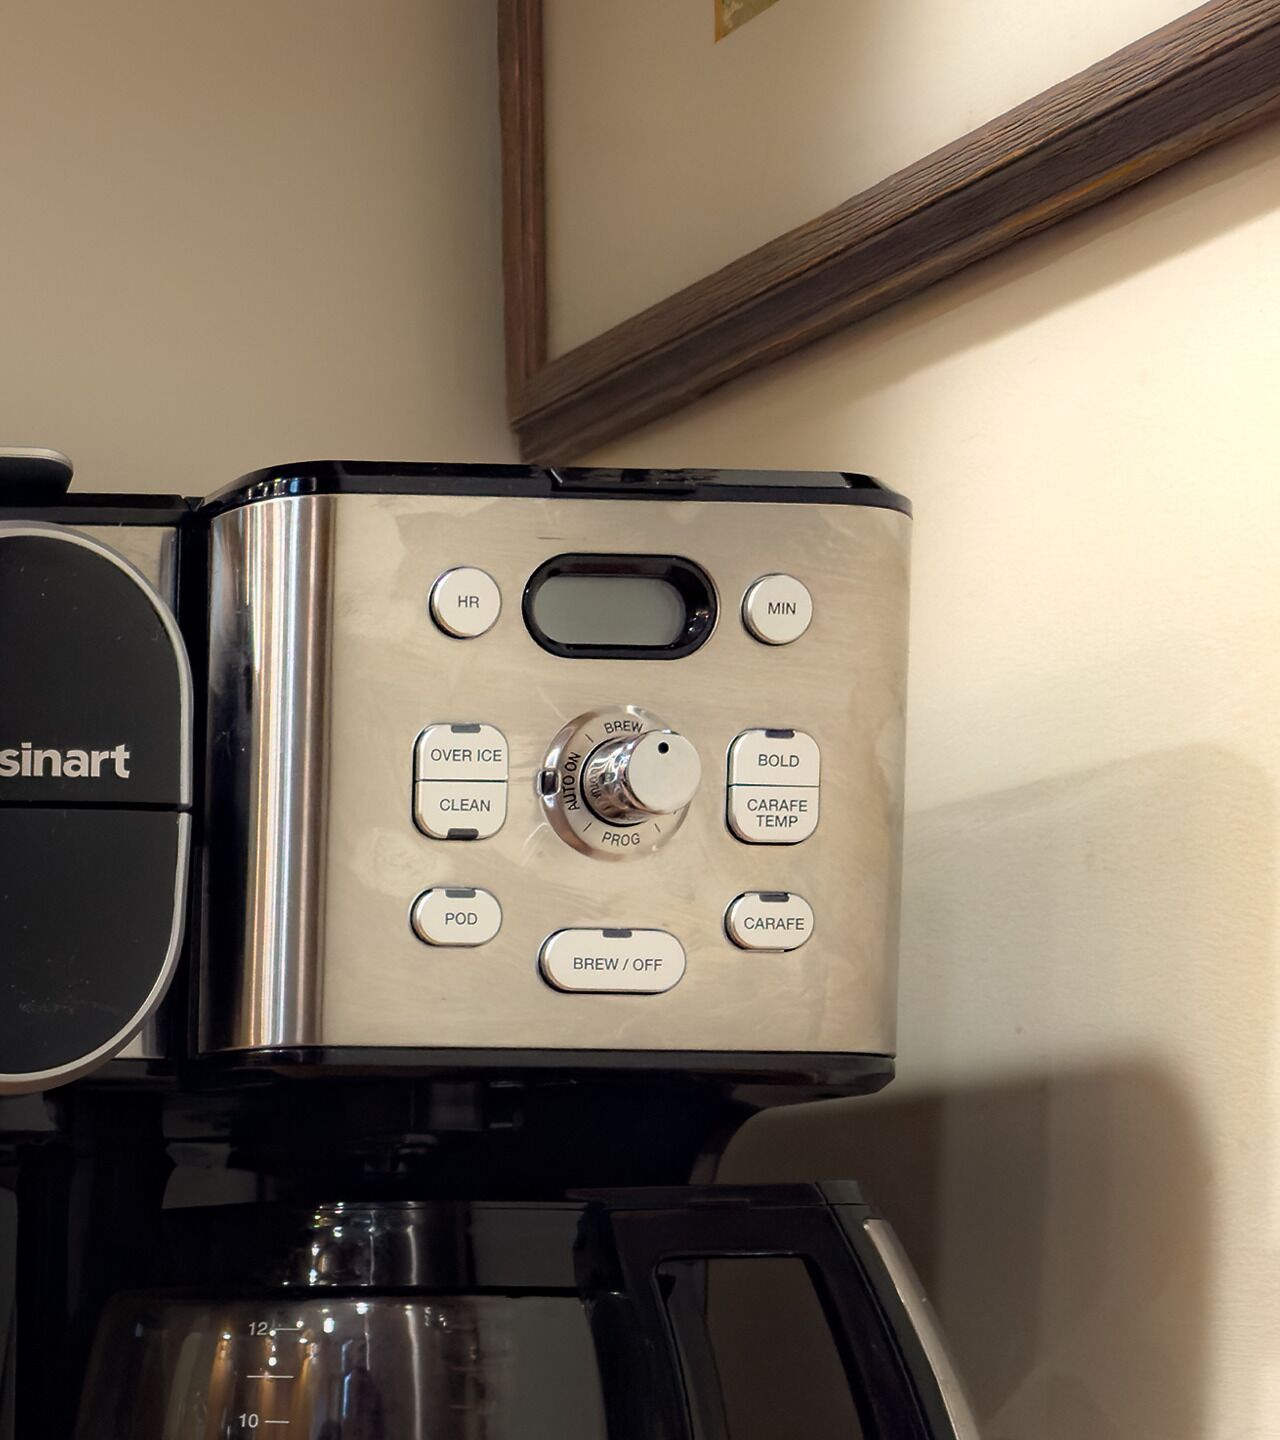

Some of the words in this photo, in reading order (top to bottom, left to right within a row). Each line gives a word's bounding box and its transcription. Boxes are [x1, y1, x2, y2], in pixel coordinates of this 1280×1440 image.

[457, 595, 480, 609] HR
[767, 602, 797, 615] MIN
[604, 720, 643, 734] BREW
[431, 749, 473, 763] OVER
[476, 749, 503, 763] ICE
[564, 751, 582, 772] ON
[757, 753, 800, 768] BOLD
[562, 775, 580, 811] AUTO
[439, 798, 491, 812] CLEAN
[746, 798, 808, 813] CARAFE
[756, 814, 799, 829] TEMP
[601, 831, 641, 847] PROG
[444, 912, 478, 926] POD
[743, 916, 805, 931] CARAFE
[573, 957, 619, 971] BREW
[632, 957, 663, 972] OFF
[248, 1321, 269, 1337] 12
[238, 1413, 260, 1429] 10
